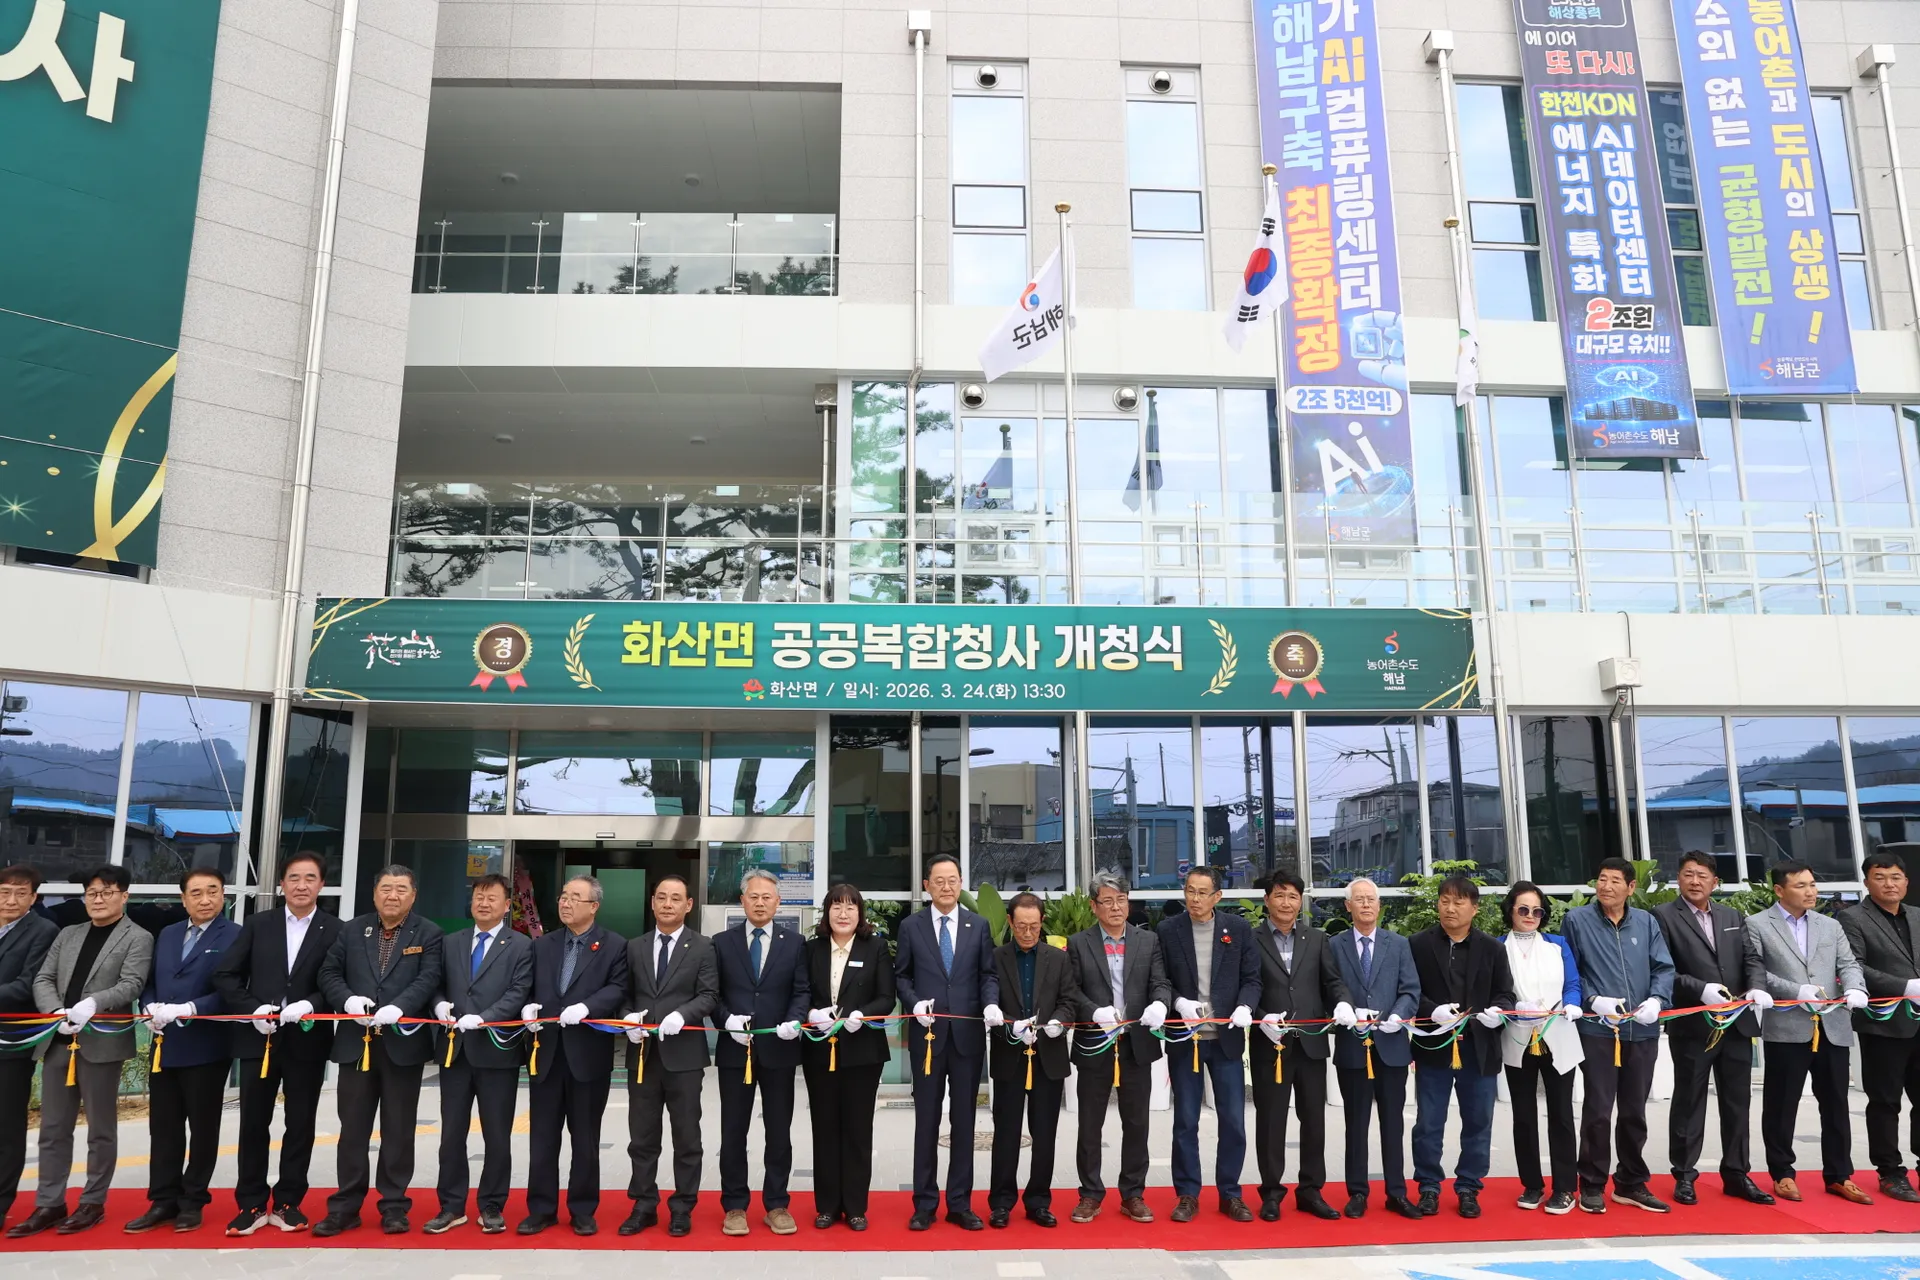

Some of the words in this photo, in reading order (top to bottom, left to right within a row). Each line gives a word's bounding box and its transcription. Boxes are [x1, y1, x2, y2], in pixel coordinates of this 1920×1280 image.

[1548, 6, 1602, 20] 해상풍력
[1694, 0, 1737, 61] 소외
[1545, 50, 1572, 75] 또
[1576, 50, 1636, 76] 다시!
[1539, 91, 1637, 117] 한전KDN
[1703, 77, 1751, 148] 없는
[1552, 123, 1597, 215] 에너지
[1771, 123, 1816, 218] 도시의
[1567, 231, 1609, 293] 특화
[1286, 184, 1341, 374] 최종확정
[1586, 298, 1654, 331] 2조원
[1576, 335, 1624, 355] 대규모
[1628, 335, 1671, 355] 유치!!
[1613, 370, 1640, 382] AI
[1775, 362, 1821, 379] 해남군
[1296, 388, 1328, 410] 2조
[1334, 388, 1392, 412] 5천억!
[1649, 428, 1681, 446] 해남
[1317, 421, 1385, 497] Ai
[1341, 526, 1371, 538] 해남군
[492, 636, 514, 660] 경
[620, 620, 755, 668] 화산면
[771, 622, 1041, 671] 공공복합청사
[1053, 624, 1184, 672] 개청식
[1285, 643, 1306, 666] 축
[1366, 658, 1420, 671] 농어촌수도
[769, 681, 818, 698] 화산면
[843, 682, 880, 699] 일시:
[885, 683, 934, 699] 2026.
[941, 684, 956, 699] 3.
[962, 683, 1017, 700] 24.(화)
[1023, 684, 1066, 699] 13:30
[1382, 672, 1406, 685] 해남
